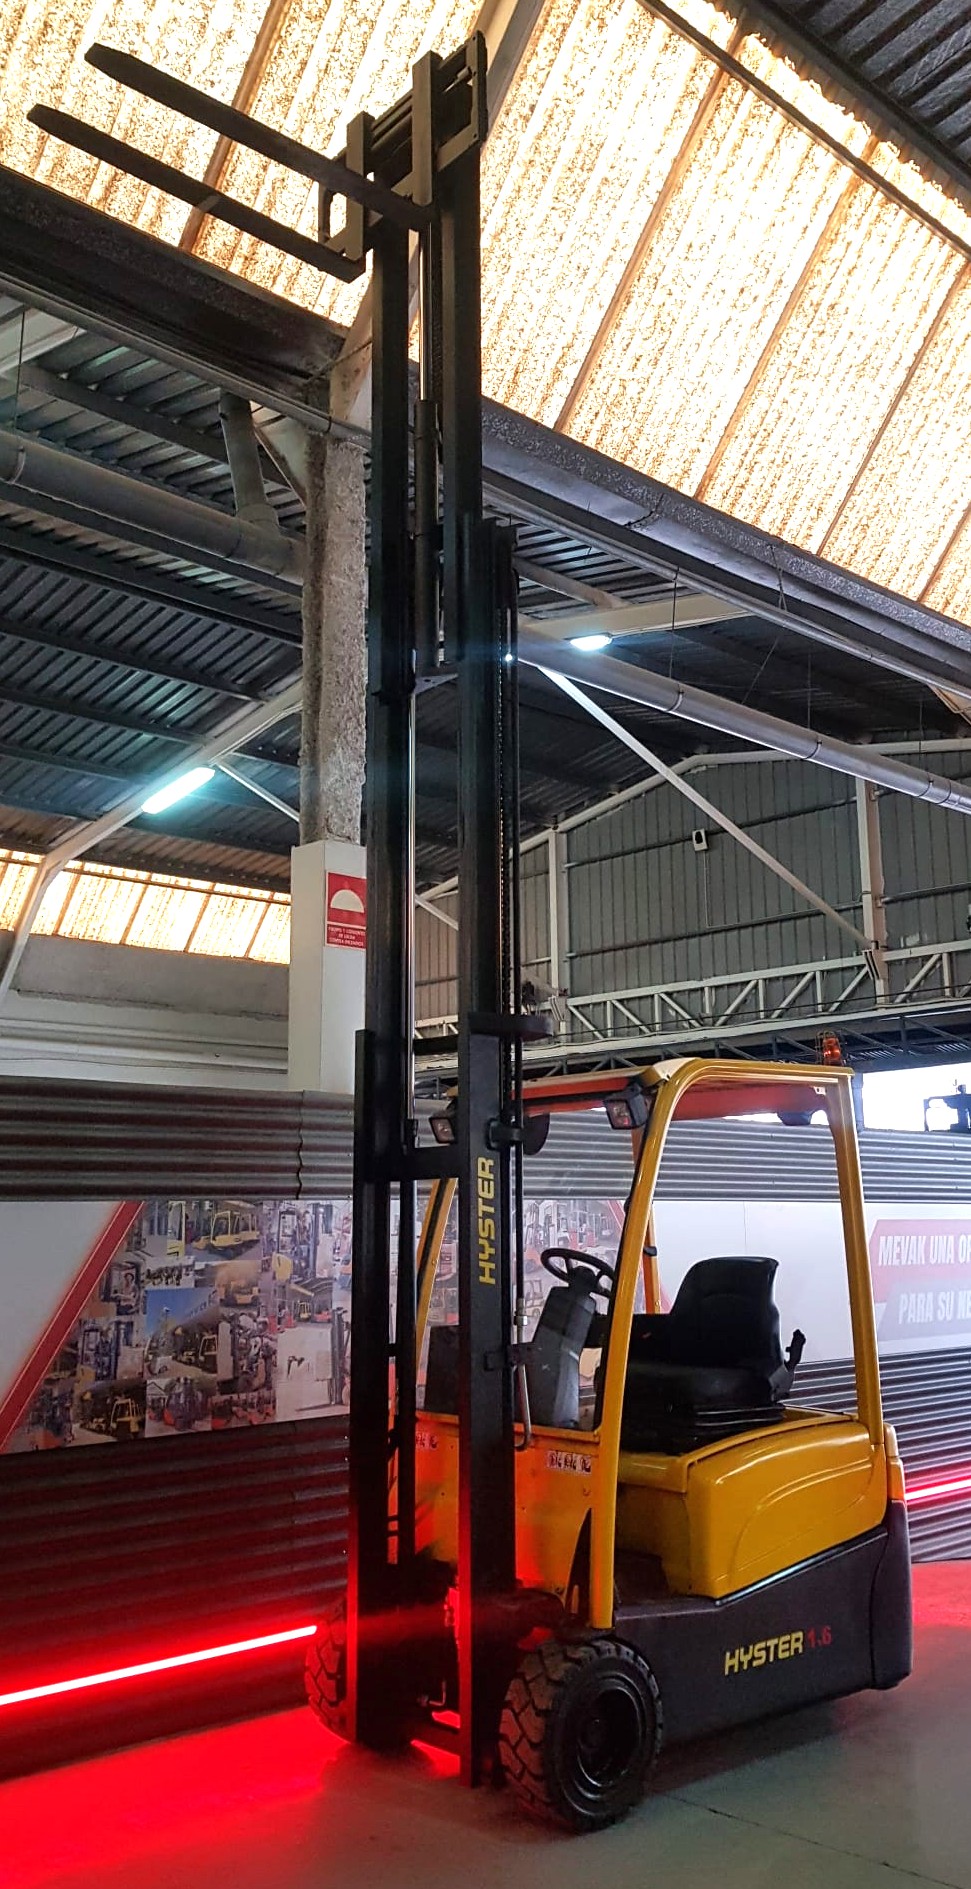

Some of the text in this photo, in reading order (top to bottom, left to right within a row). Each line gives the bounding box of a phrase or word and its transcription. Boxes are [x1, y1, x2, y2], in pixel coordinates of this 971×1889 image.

[477, 1156, 496, 1285] HYSTER
[878, 1235, 926, 1266] MEVAK
[929, 1235, 954, 1265] UNA
[899, 1292, 933, 1324] PARA
[937, 1290, 955, 1321] SU
[724, 1624, 832, 1676] HYSTER 1.6
